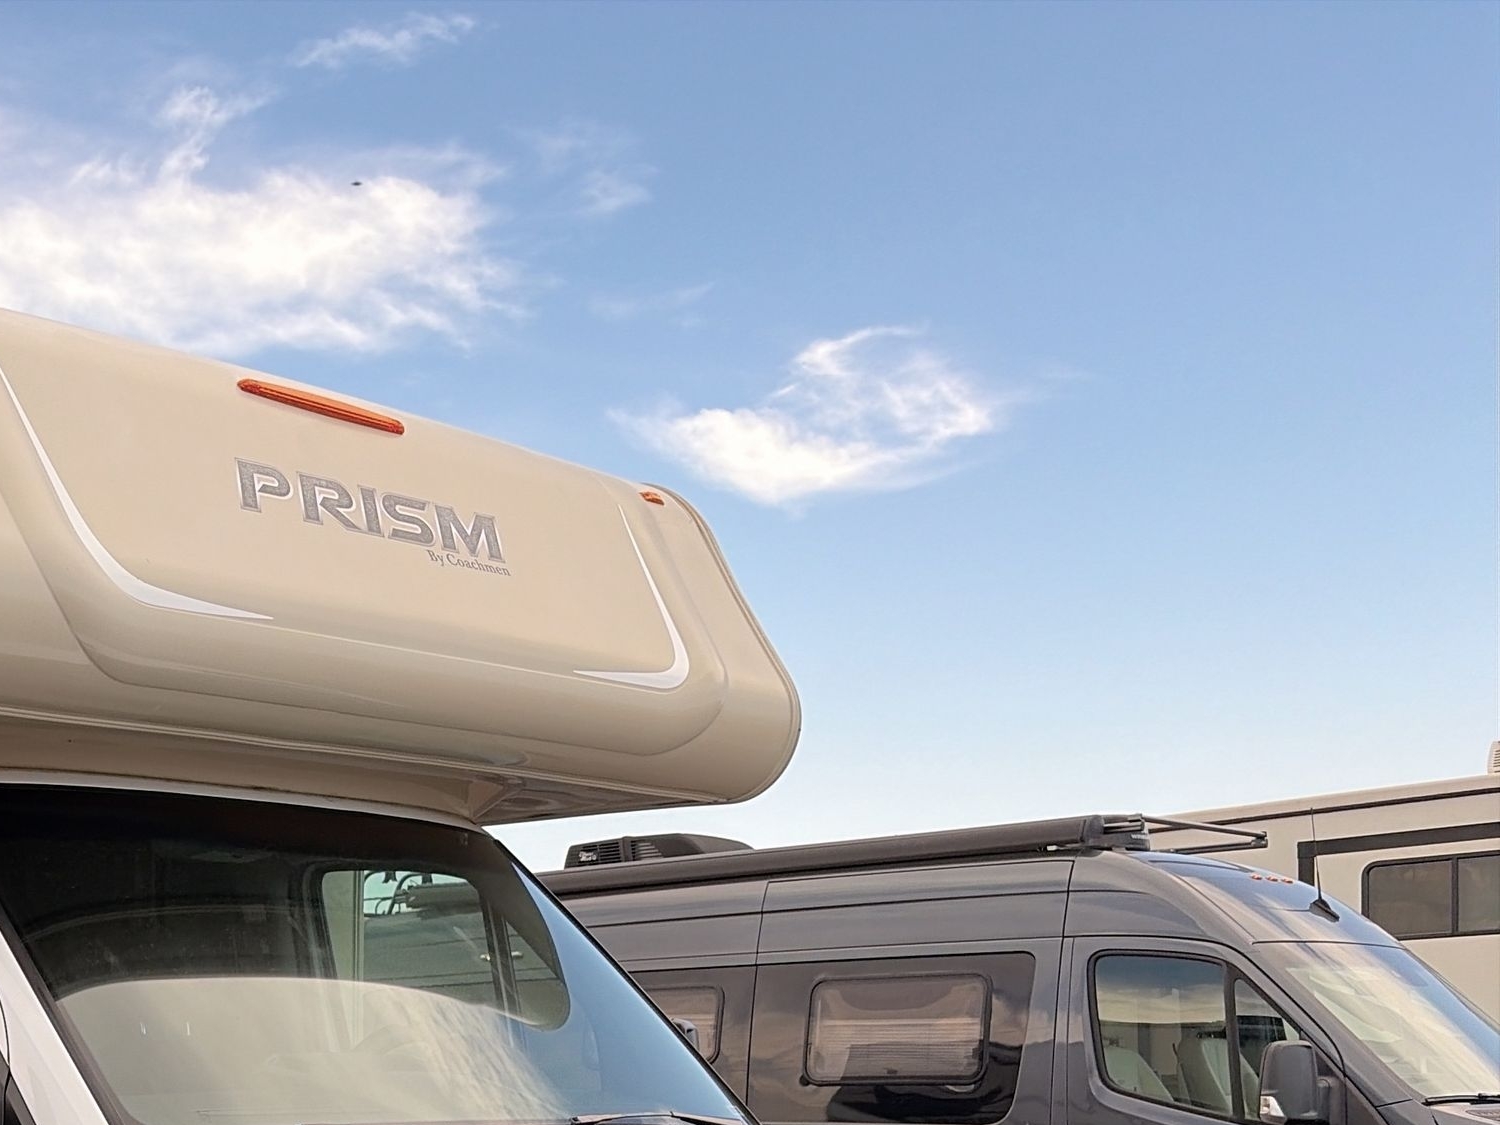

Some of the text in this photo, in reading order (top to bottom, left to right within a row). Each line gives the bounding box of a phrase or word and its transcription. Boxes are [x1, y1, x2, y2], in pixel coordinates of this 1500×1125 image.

[235, 457, 505, 564] PRISM
[427, 549, 511, 577] By Coachmen
